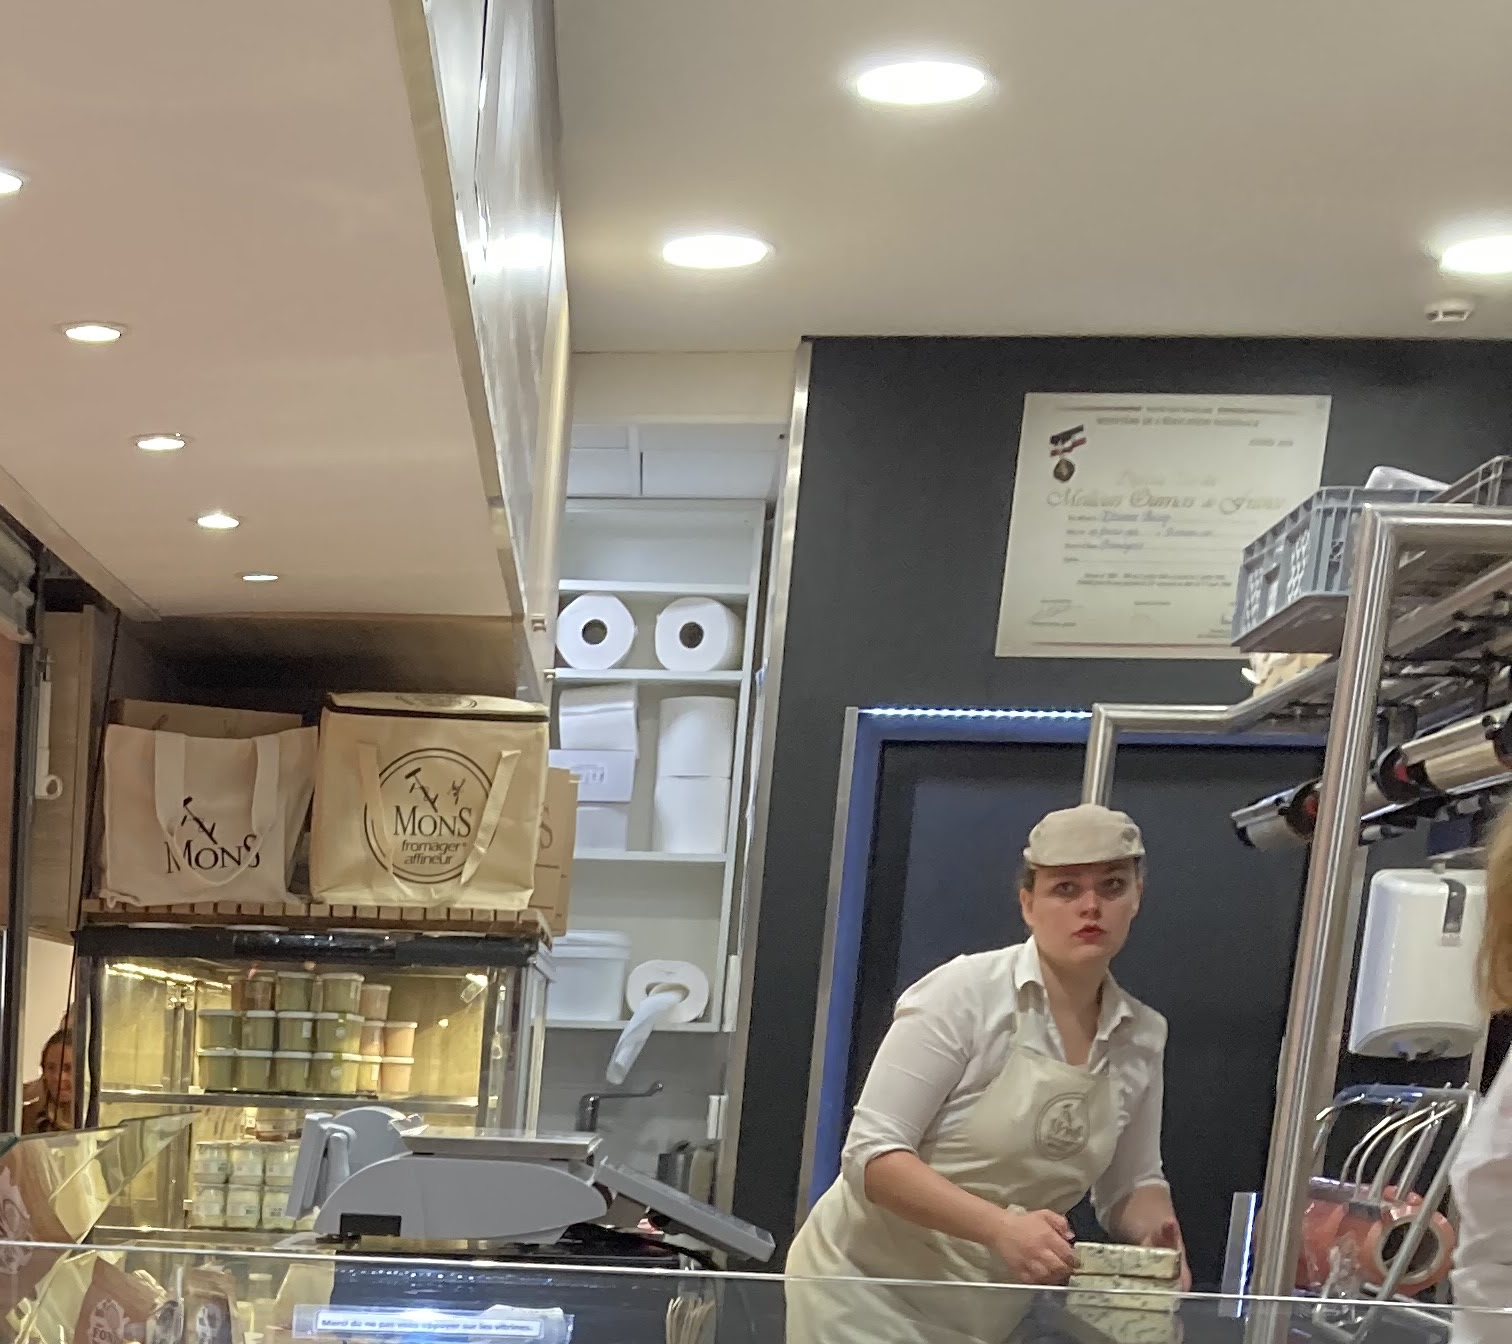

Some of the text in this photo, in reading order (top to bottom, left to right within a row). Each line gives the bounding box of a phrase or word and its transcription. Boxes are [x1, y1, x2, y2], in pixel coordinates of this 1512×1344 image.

[393, 804, 473, 838] MONS
[401, 839, 462, 854] fromager
[404, 852, 454, 866] affineur
